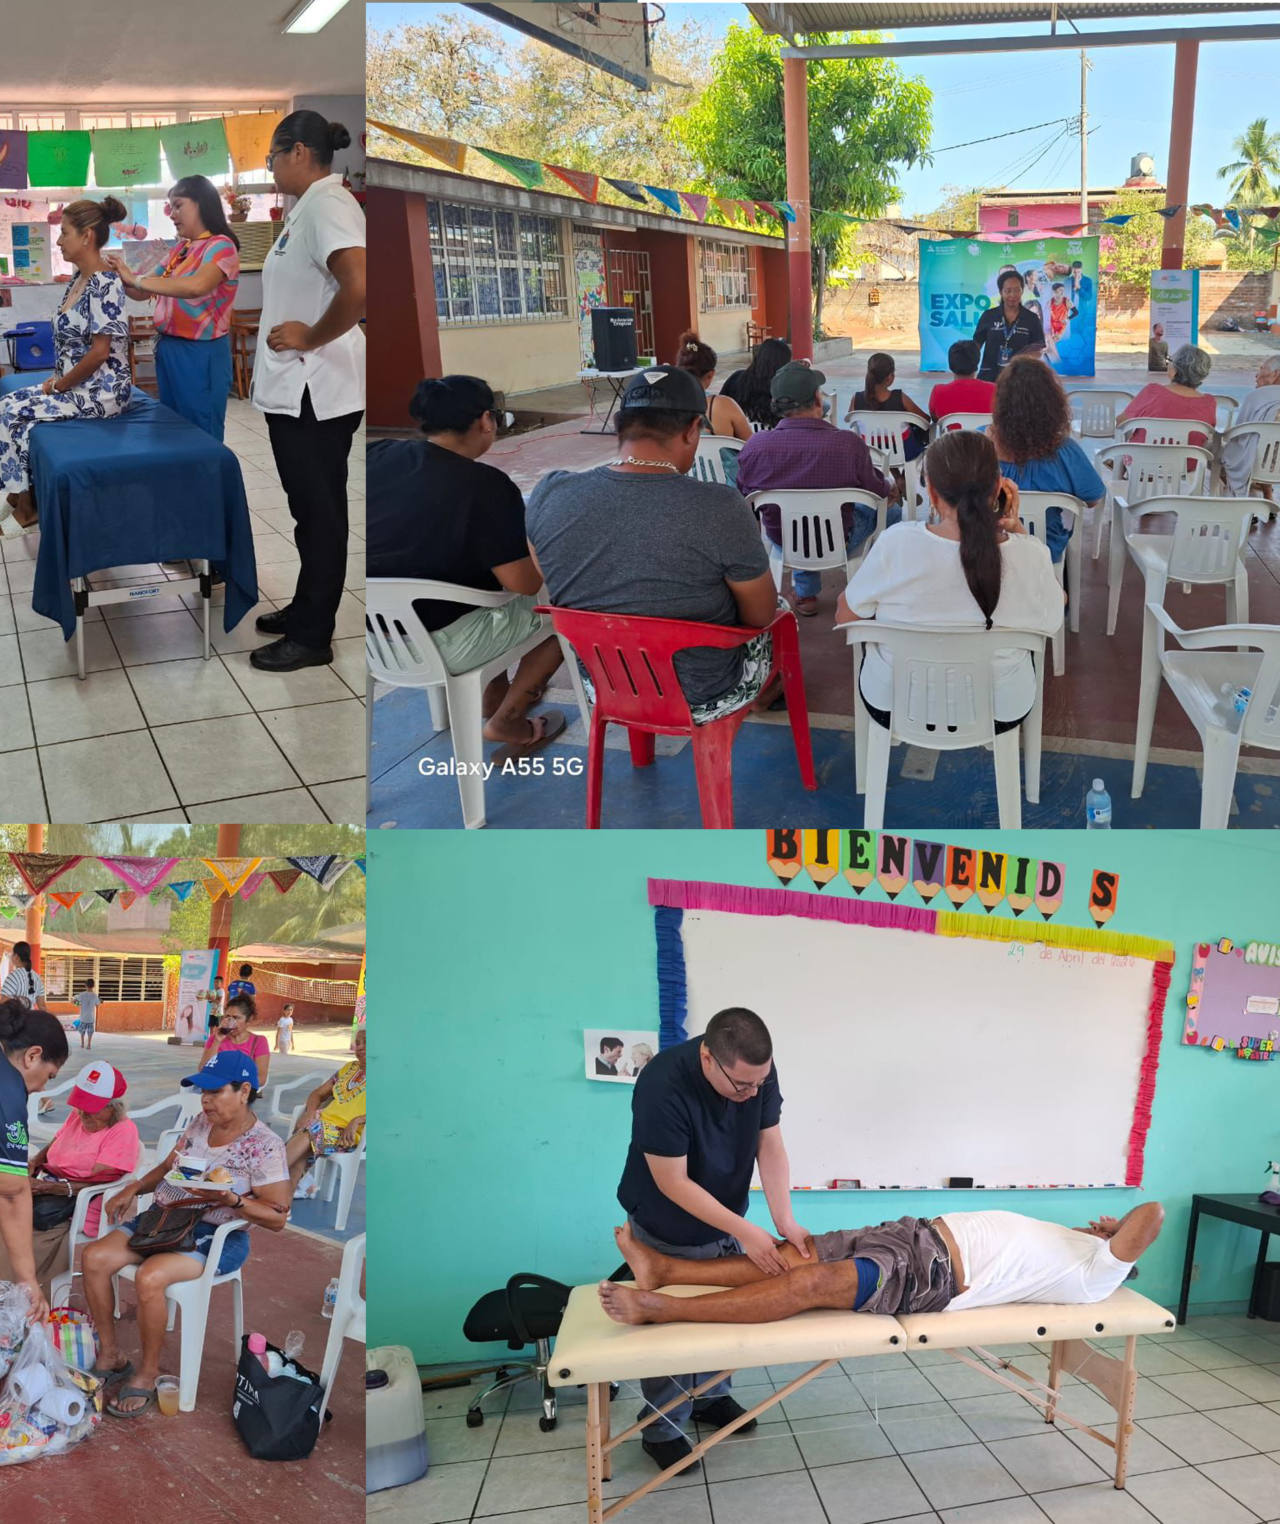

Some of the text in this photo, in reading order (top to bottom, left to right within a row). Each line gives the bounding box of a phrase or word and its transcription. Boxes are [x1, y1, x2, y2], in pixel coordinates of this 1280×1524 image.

[930, 293, 991, 310] EXPO
[1007, 943, 1024, 957] 29
[1040, 949, 1052, 960] de
[1058, 949, 1084, 965] Abril
[1241, 1036, 1274, 1052] SUPER
